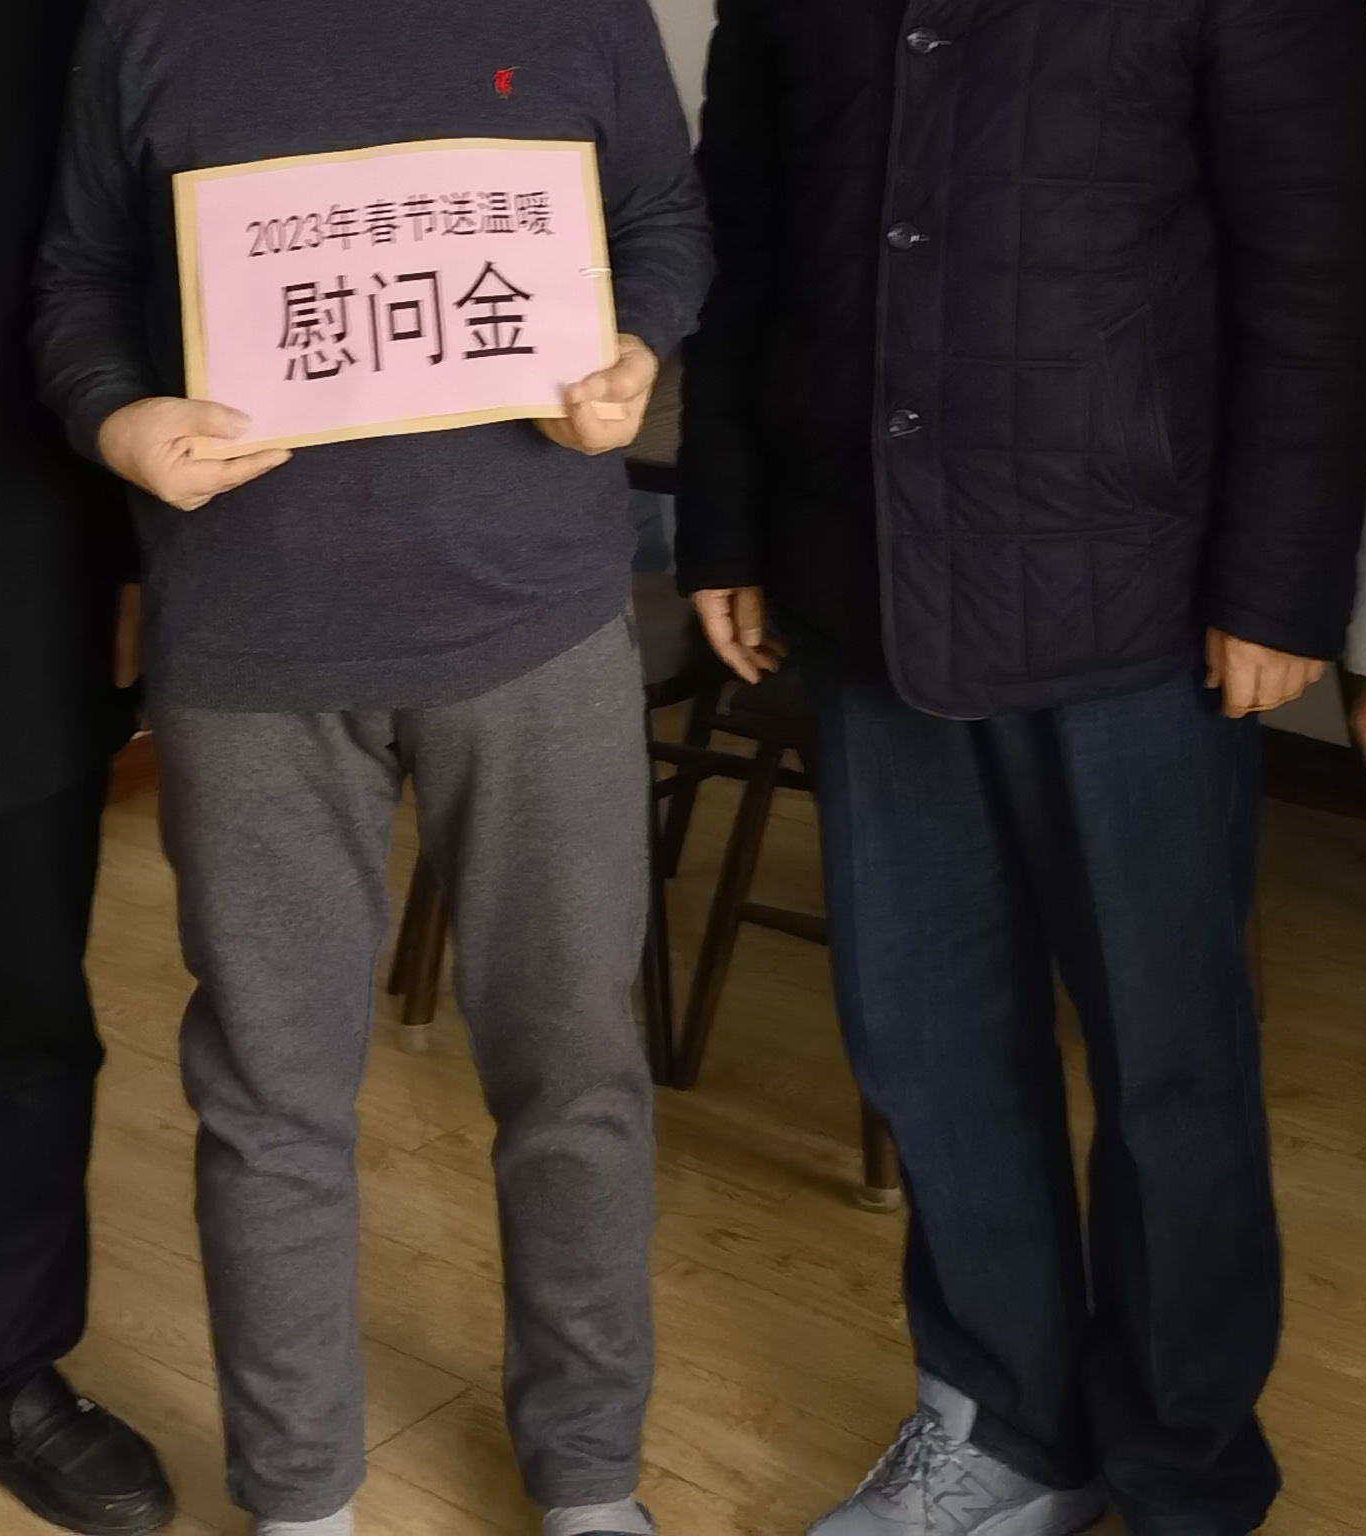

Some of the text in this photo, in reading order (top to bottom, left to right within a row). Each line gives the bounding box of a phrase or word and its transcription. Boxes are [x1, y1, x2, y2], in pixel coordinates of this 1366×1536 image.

[246, 190, 556, 257] 2023年春节送温暖
[275, 260, 538, 381] 慰问金
